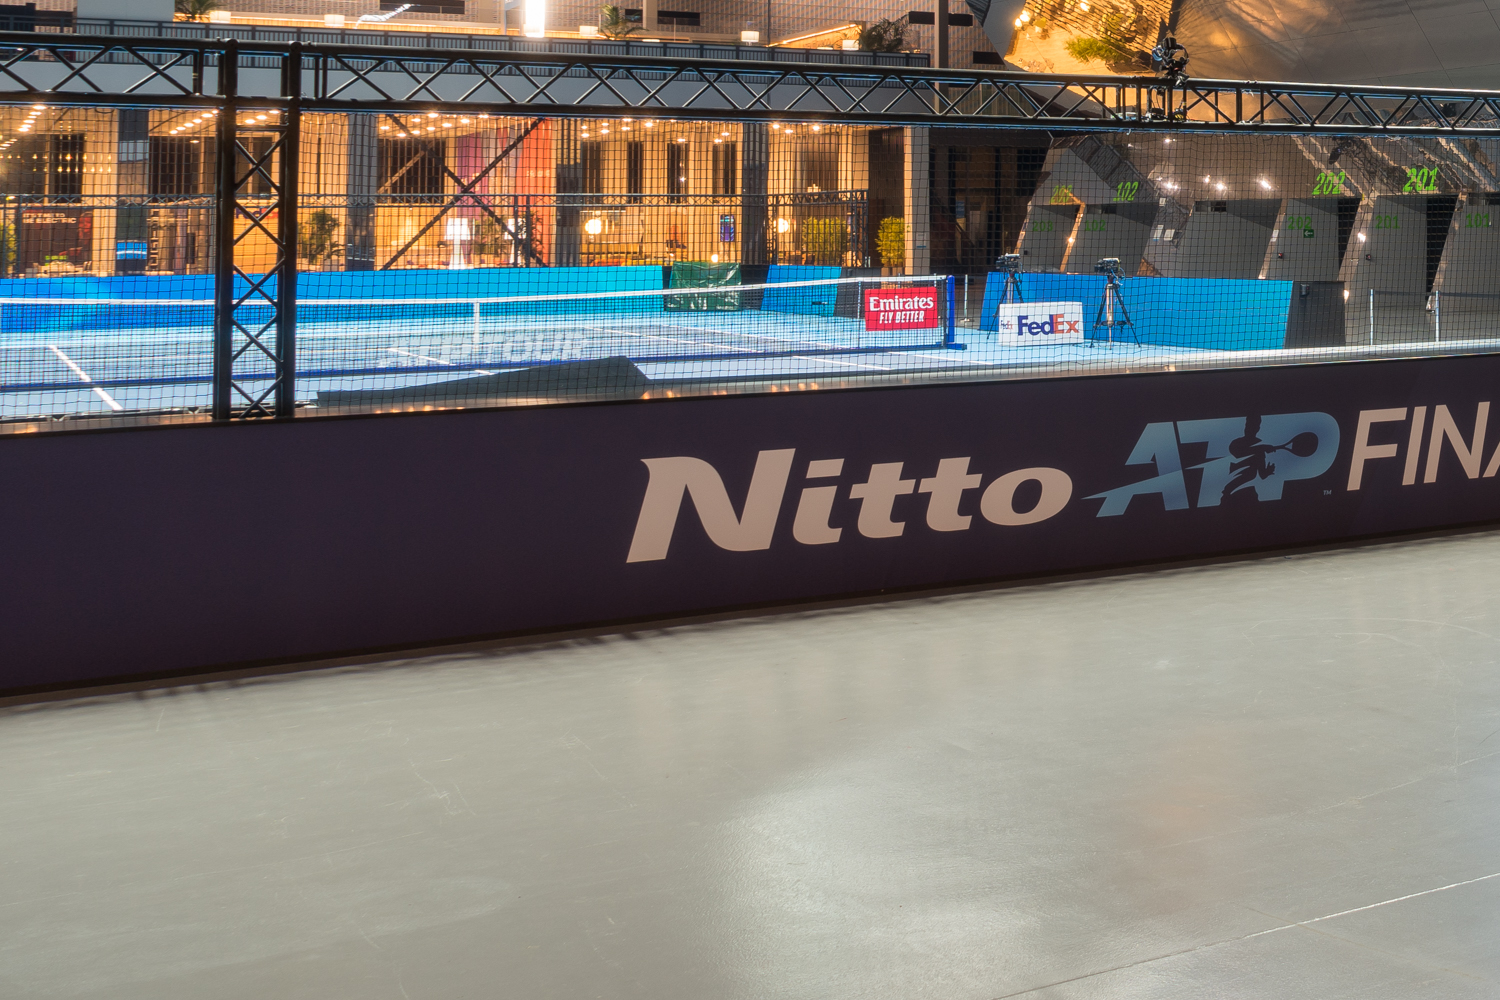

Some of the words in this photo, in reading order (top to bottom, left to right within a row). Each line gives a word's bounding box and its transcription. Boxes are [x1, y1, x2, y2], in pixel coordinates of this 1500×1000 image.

[1312, 172, 1346, 195] 202
[1403, 167, 1438, 192] 201
[1112, 181, 1139, 202] 102
[1084, 220, 1106, 232] 102
[1287, 216, 1312, 230] 202
[1375, 215, 1400, 229] 201
[1465, 213, 1490, 228] 101
[869, 295, 934, 311] Emirates
[879, 312, 894, 324] FLY
[895, 310, 925, 323] BETTER
[1017, 313, 1080, 336] FedEx
[626, 448, 1074, 563] Nitto
[1080, 411, 1341, 518] ATP
